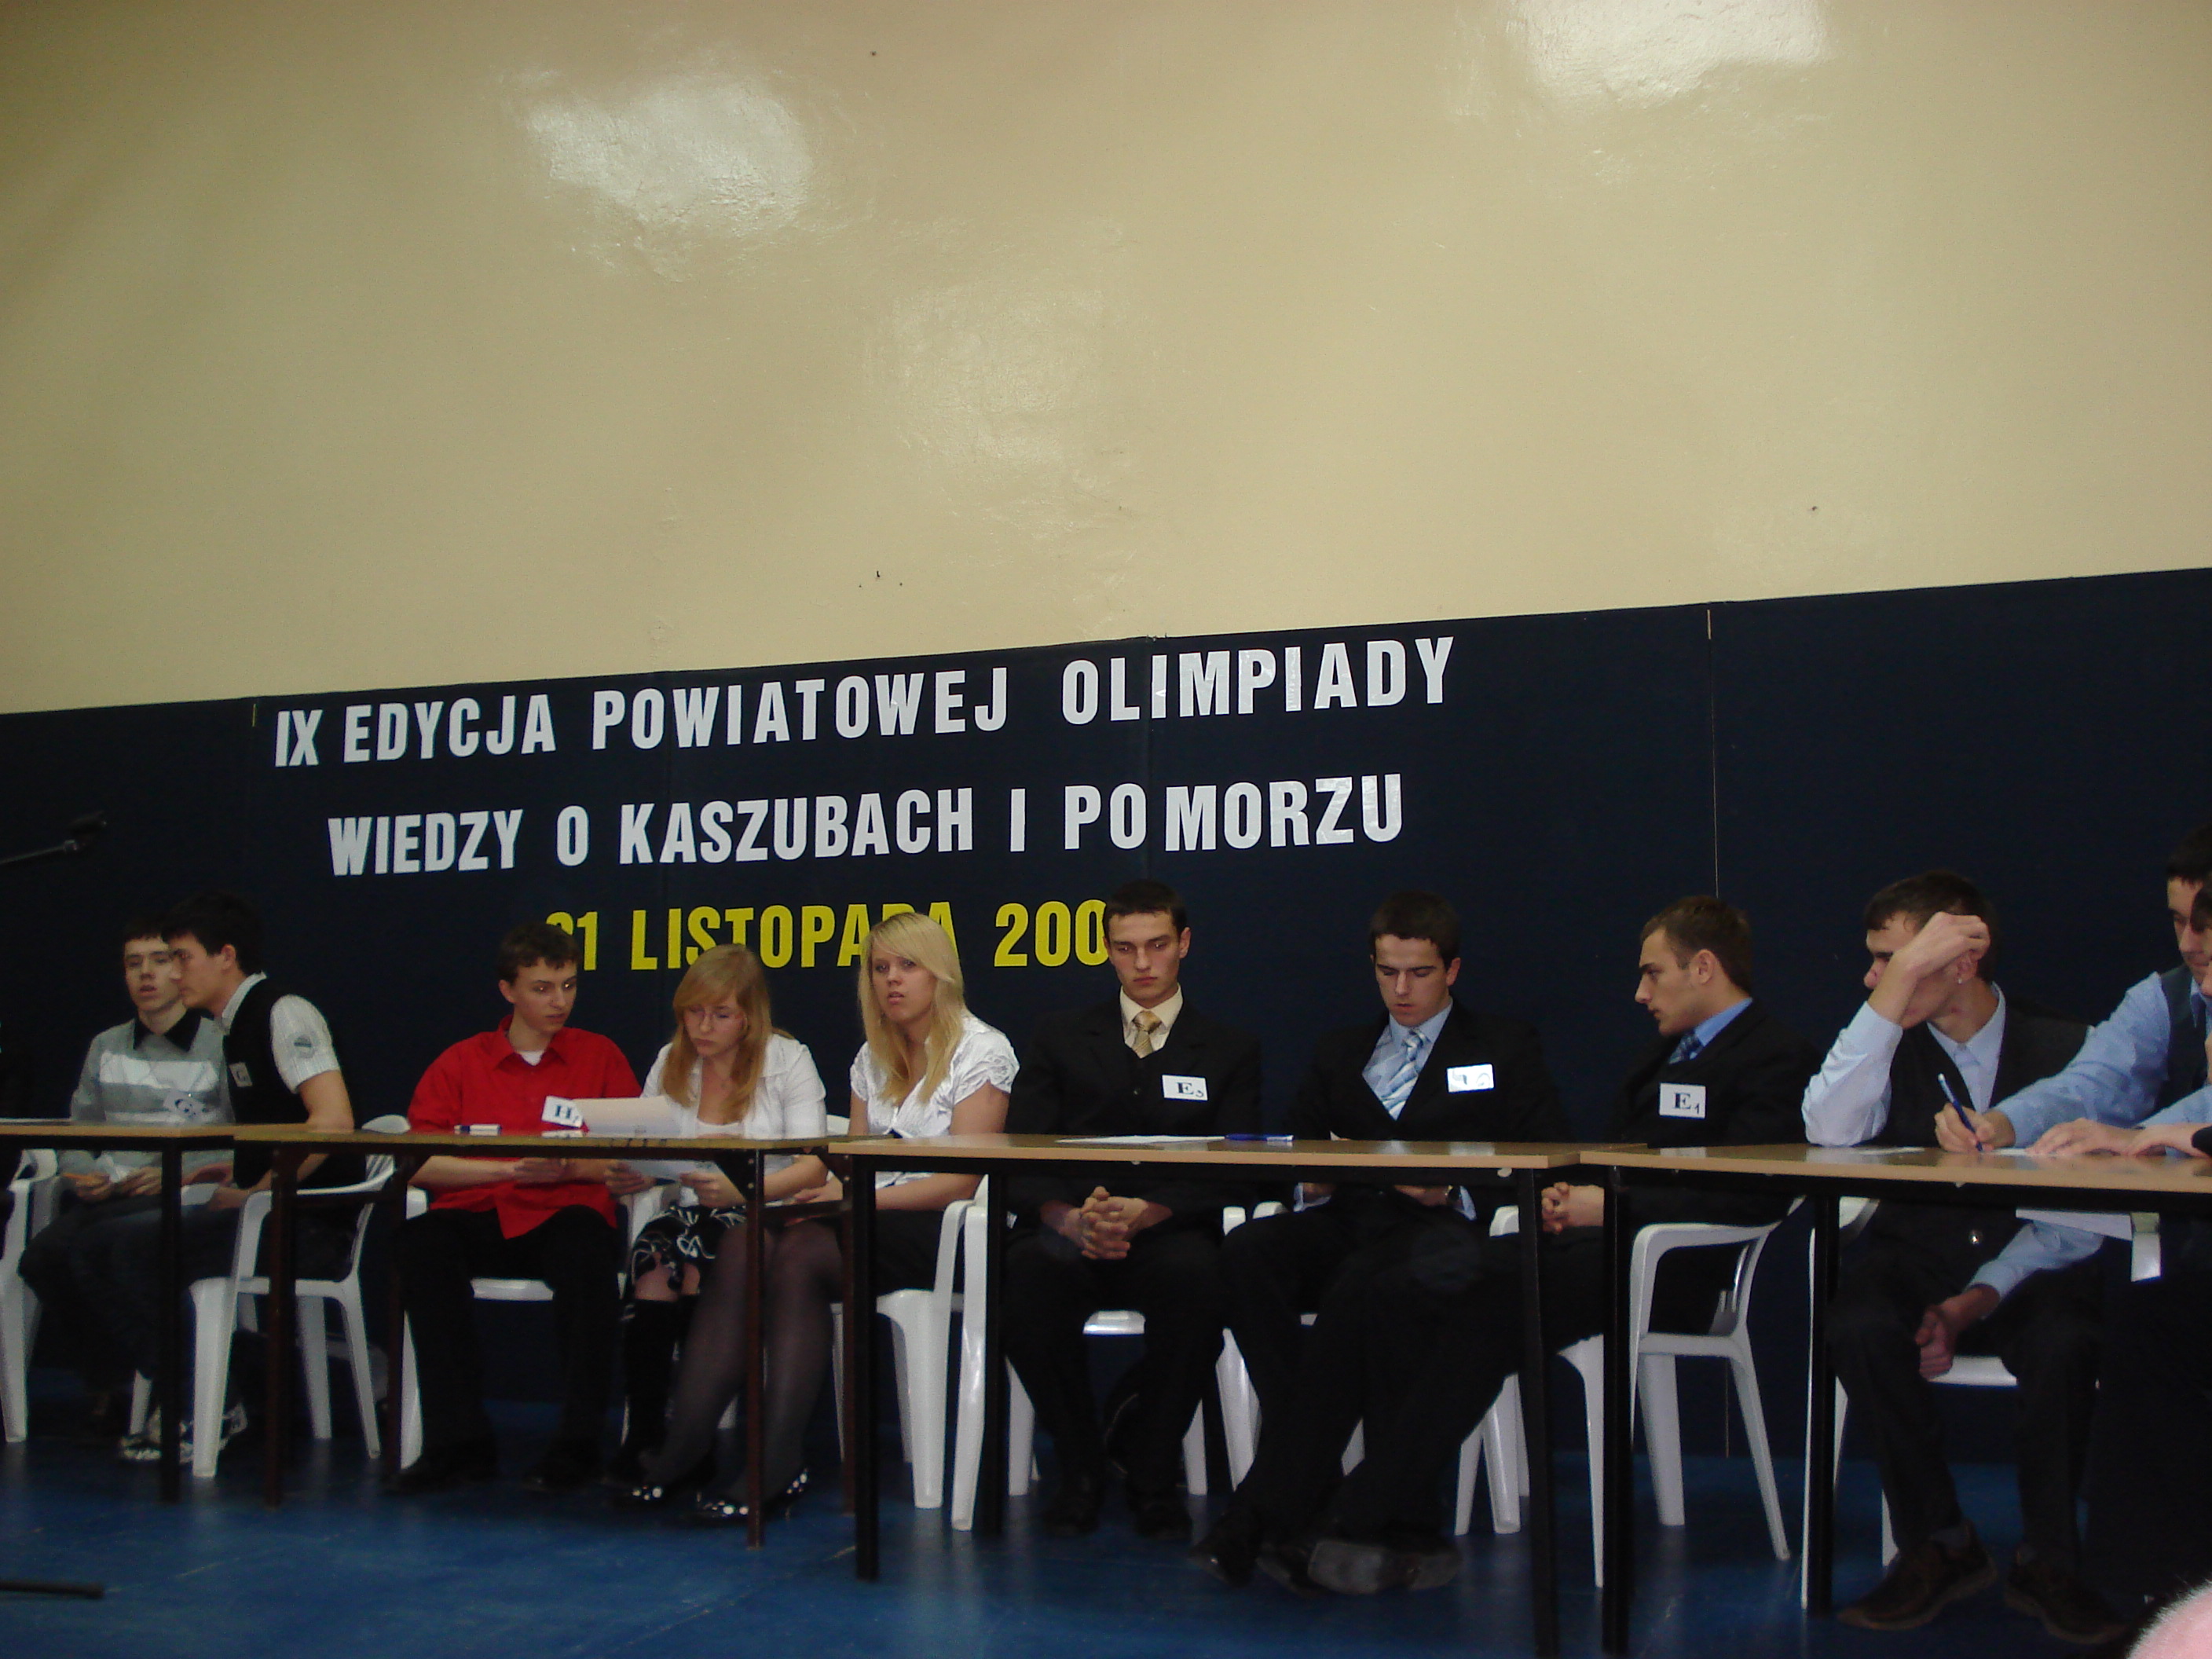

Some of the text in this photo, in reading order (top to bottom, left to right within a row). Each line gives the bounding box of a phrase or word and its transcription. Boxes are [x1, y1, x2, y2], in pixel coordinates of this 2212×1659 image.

[275, 635, 1455, 767] IX EDYCJA POWIATOWEJ OLIMPIADY
[328, 808, 523, 877] WIEDZY
[556, 805, 589, 866] O
[619, 787, 973, 865] KASZUBACH
[1009, 788, 1026, 852] I
